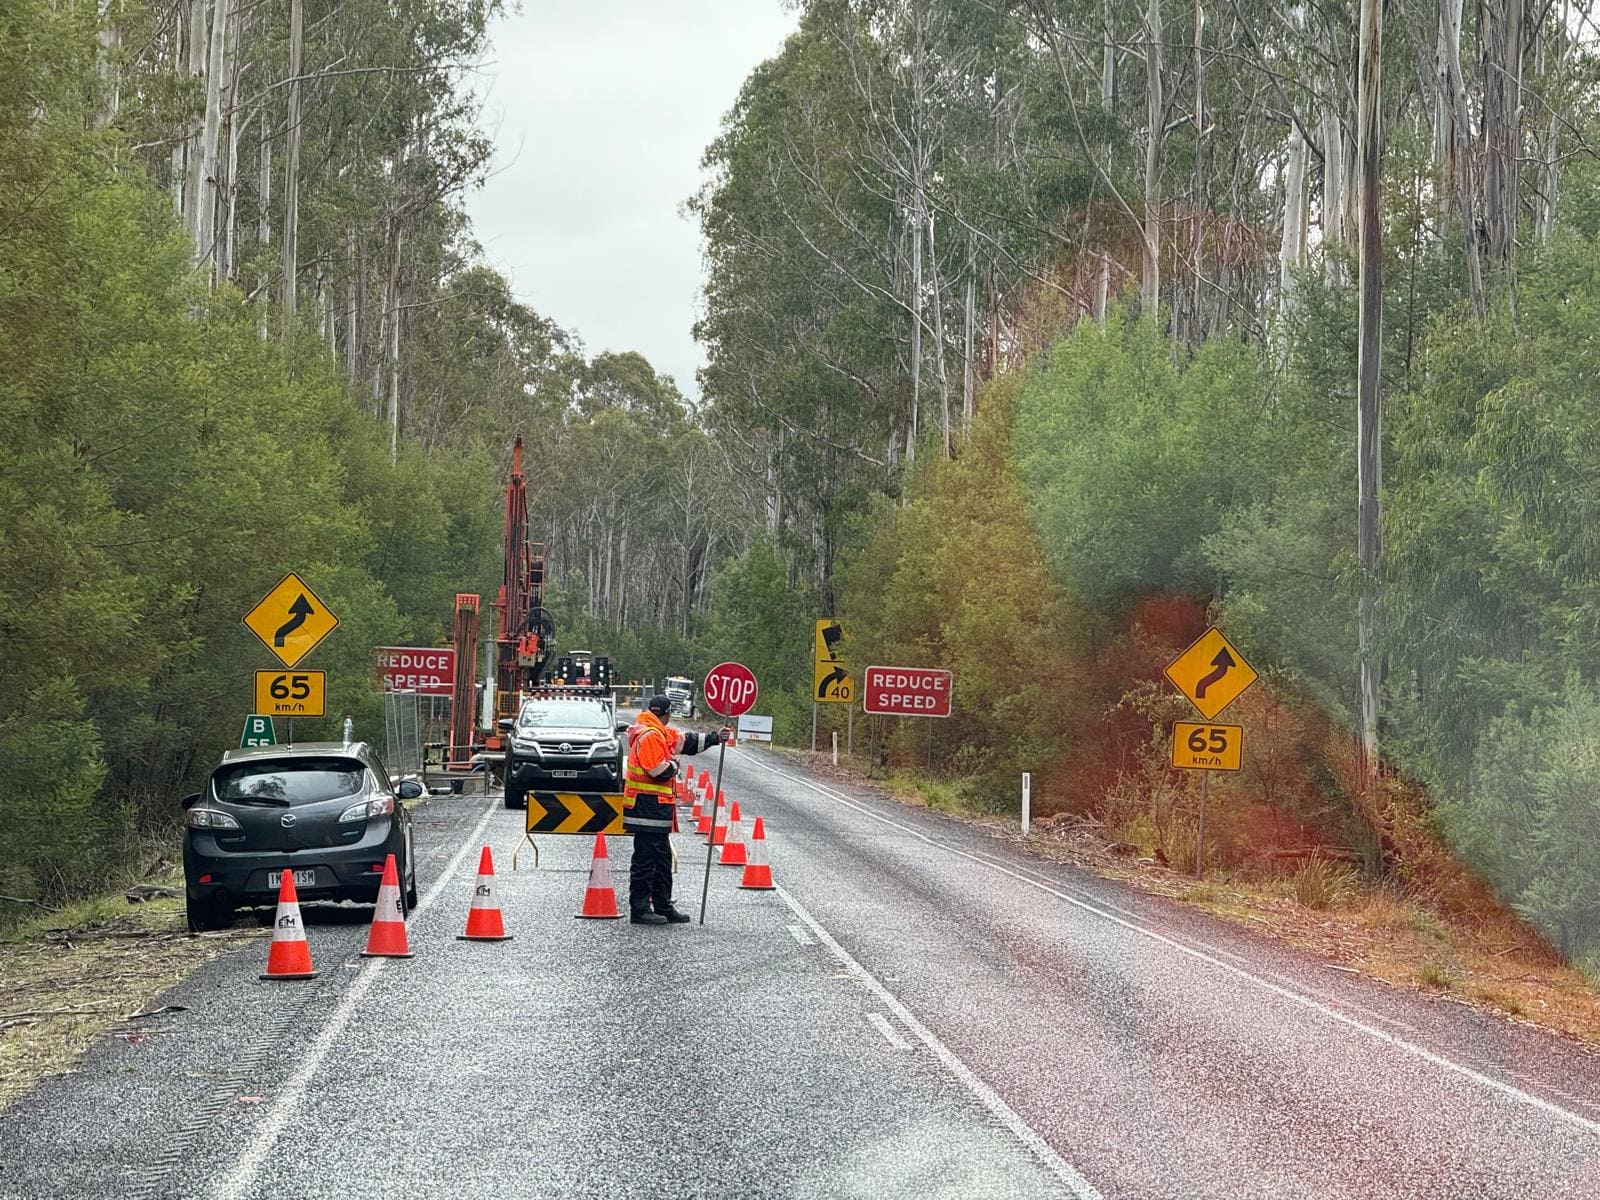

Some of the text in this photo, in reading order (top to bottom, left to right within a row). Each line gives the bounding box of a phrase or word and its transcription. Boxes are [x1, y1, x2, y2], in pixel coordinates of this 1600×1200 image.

[270, 674, 310, 700] 65
[707, 674, 755, 705] STOP
[873, 674, 944, 690] REDUCE
[831, 686, 850, 699] 40
[274, 702, 305, 712] km/h
[878, 693, 936, 709] SPEED
[253, 719, 265, 733] B
[1187, 728, 1228, 754] 65
[1191, 755, 1222, 766] km/h
